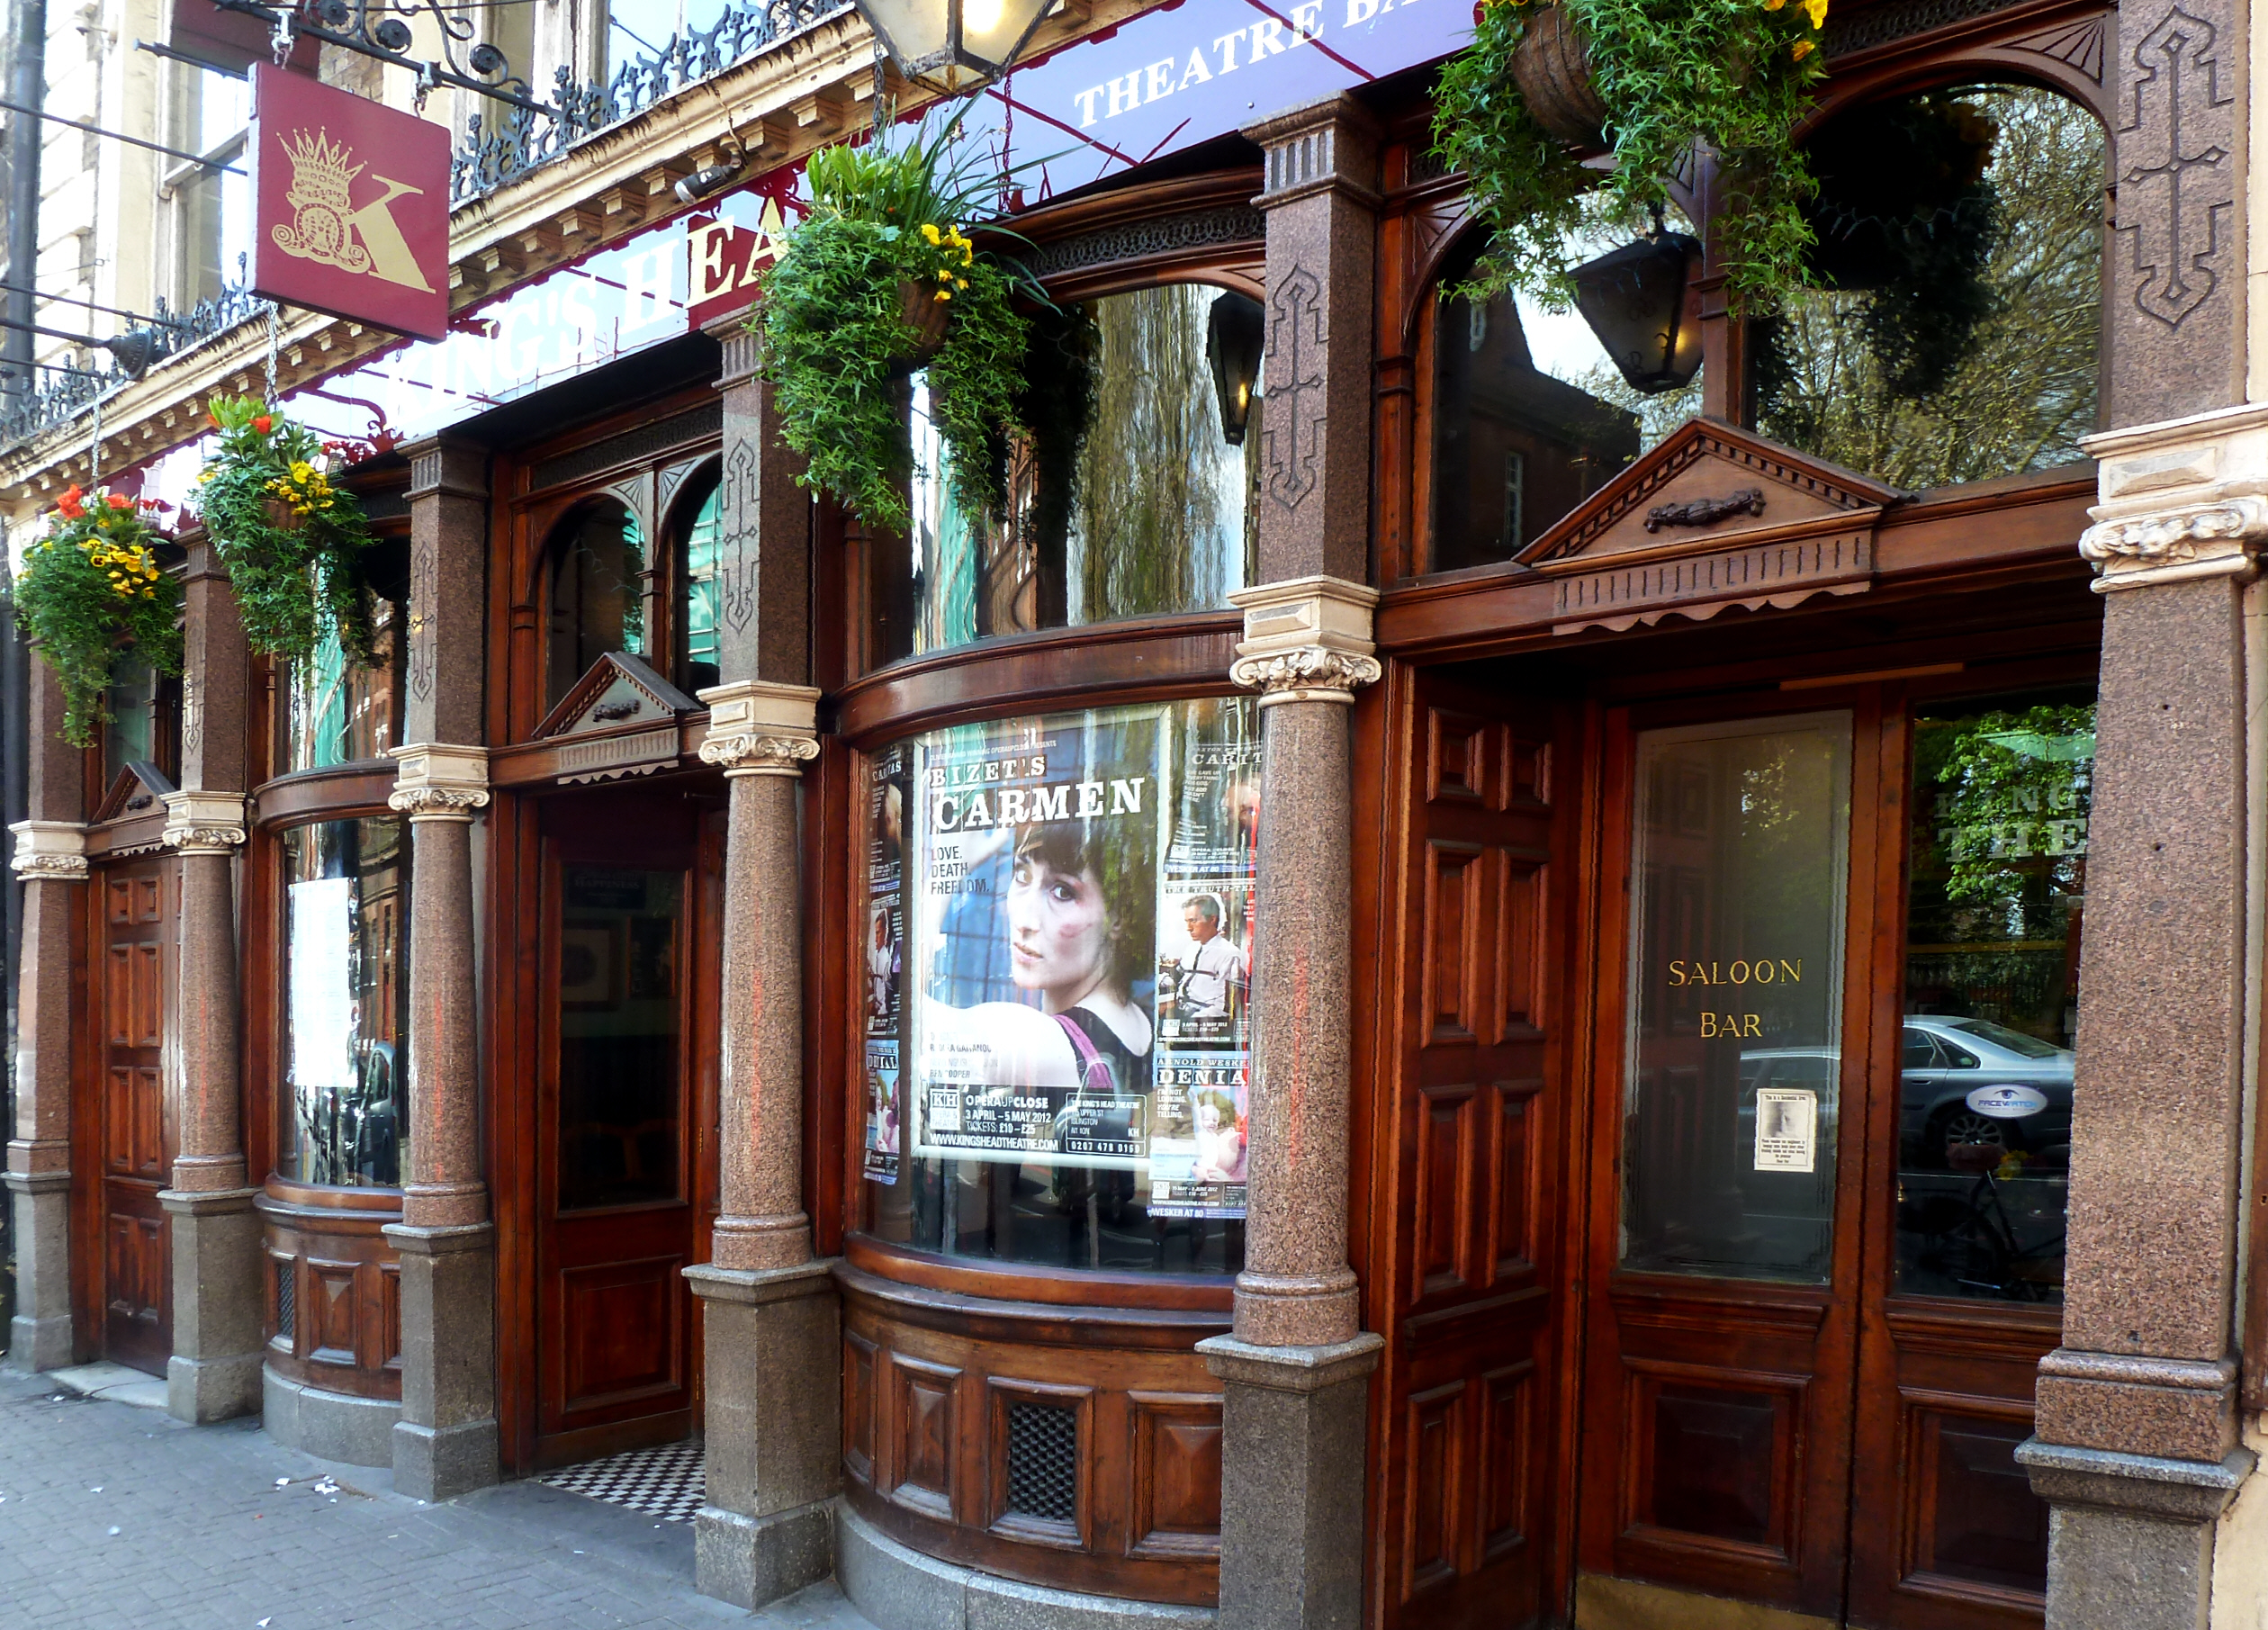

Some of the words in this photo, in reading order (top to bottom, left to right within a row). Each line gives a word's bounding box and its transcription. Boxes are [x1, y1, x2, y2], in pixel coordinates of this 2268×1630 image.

[1074, 3, 1325, 129] THEATRE
[1342, 0, 1419, 28] B
[322, 169, 436, 294] K
[384, 275, 597, 428] KING'S
[931, 756, 1046, 788] BIZET'S
[933, 777, 1146, 832] CARMEN
[1933, 784, 2081, 819] KNG
[1199, 865, 1210, 873] AT
[1668, 958, 1803, 987] SALOON
[1699, 1011, 1764, 1039] BAR
[1157, 1058, 1203, 1066] ARNOLD
[932, 1092, 958, 1107] KH
[1171, 1088, 1183, 1096] NOT
[966, 1094, 1049, 1110] OPERAUPCLOSE
[1101, 1100, 1115, 1109] HEAD
[965, 1109, 971, 1121] 3
[972, 1109, 998, 1121] APRIL
[1004, 1111, 1011, 1122] 5
[1011, 1111, 1031, 1123] MAY
[1032, 1112, 1052, 1124] 2012
[1097, 1110, 1104, 1118] ST
[998, 1121, 1014, 1134] £10
[1021, 1123, 1036, 1135] £25
[1128, 1127, 1140, 1138] KH
[930, 1133, 1060, 1153] WWW.KINGSHEADTHEATRE.COM
[1071, 1140, 1094, 1151] 0207
[1184, 1208, 1194, 1218] AT
